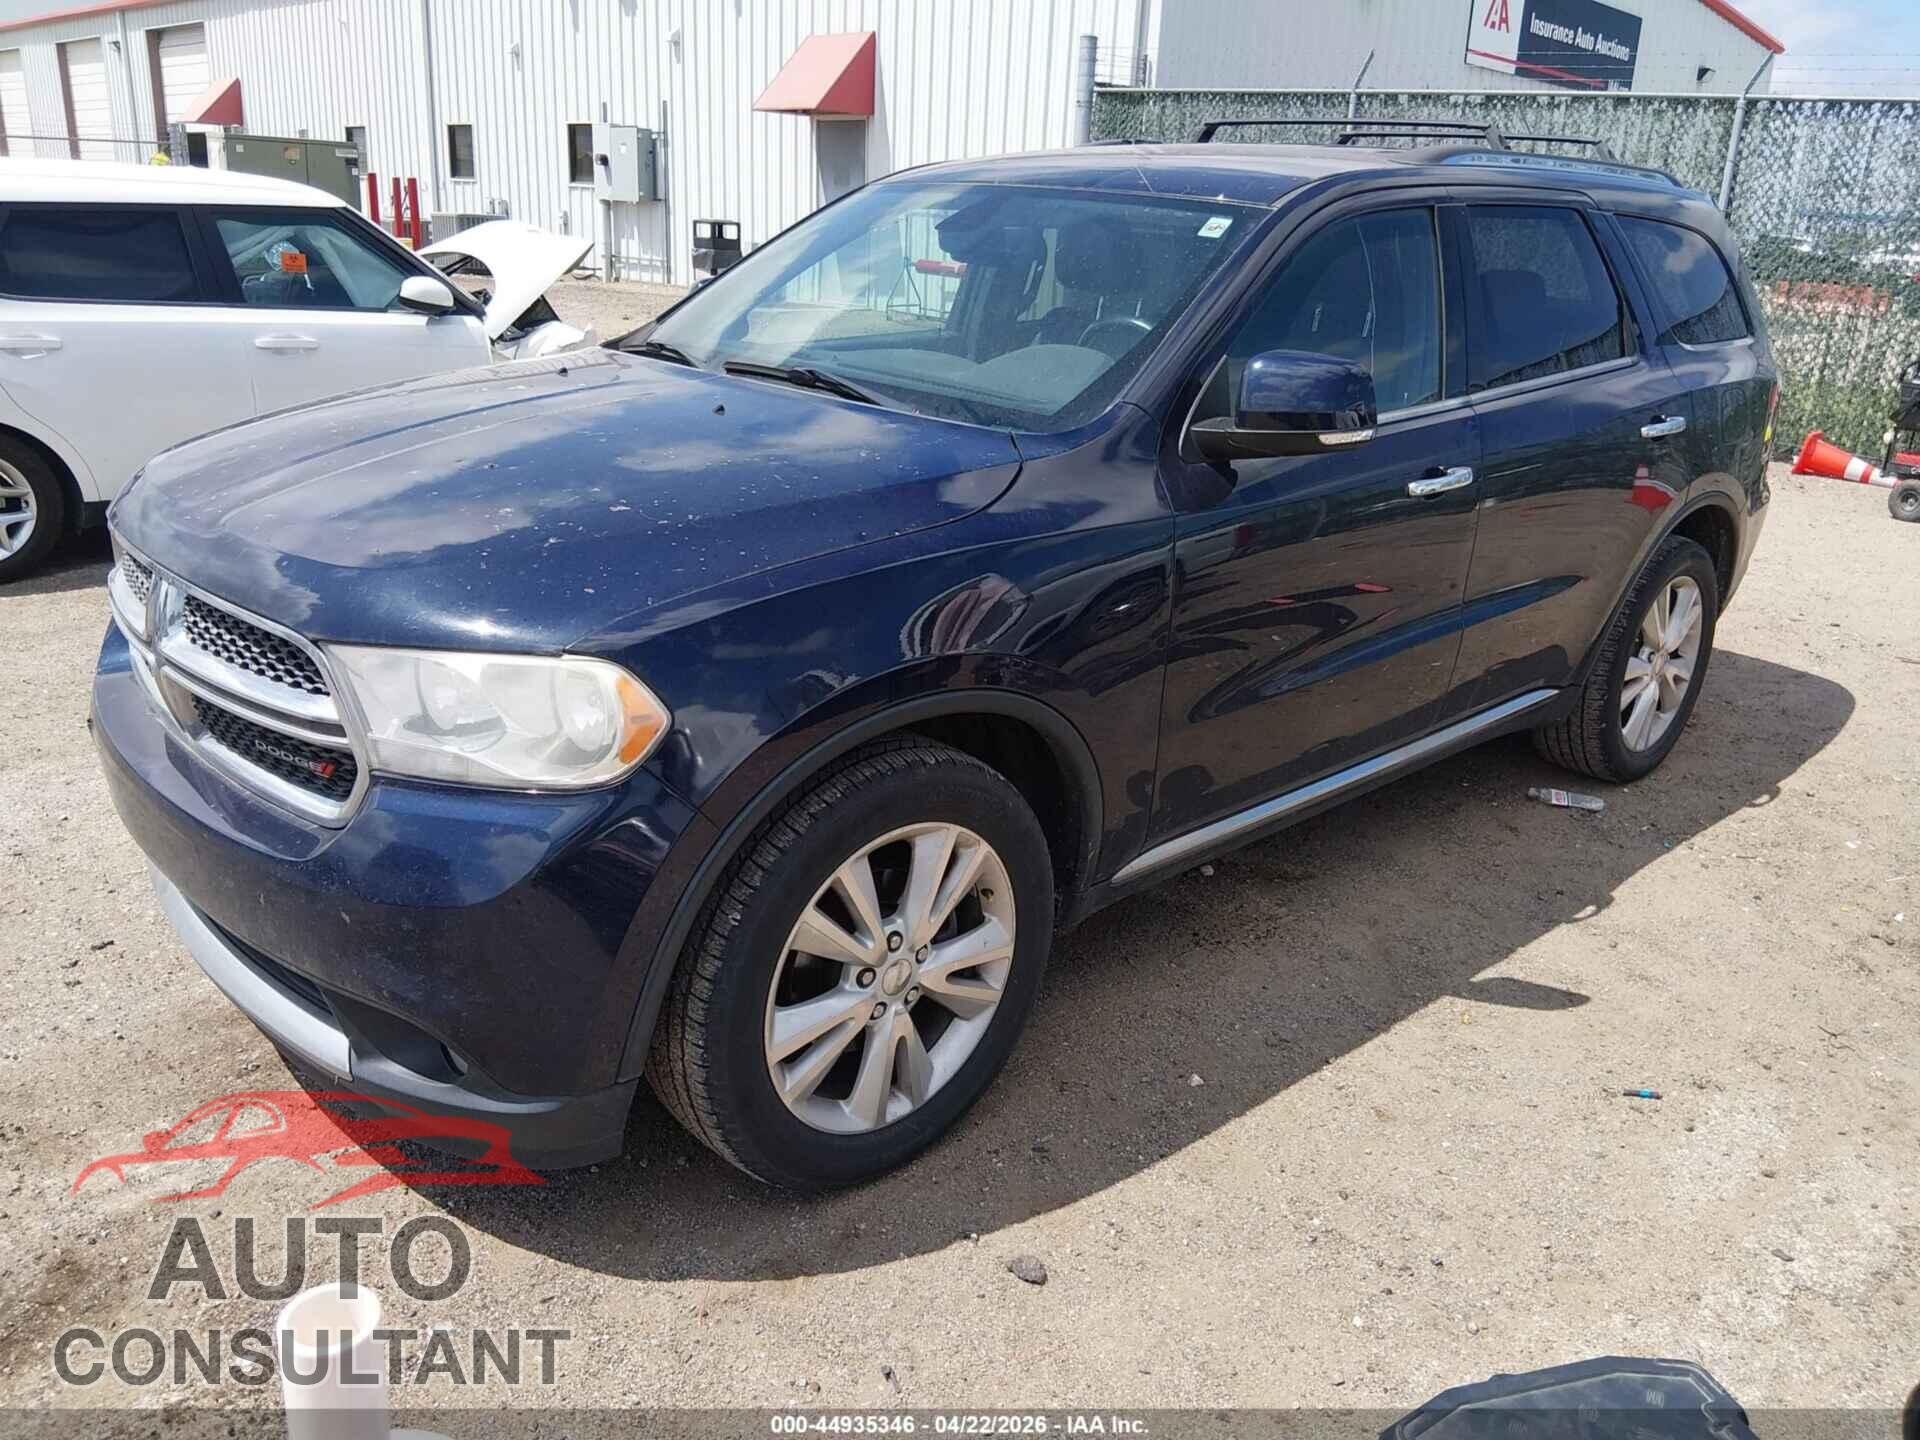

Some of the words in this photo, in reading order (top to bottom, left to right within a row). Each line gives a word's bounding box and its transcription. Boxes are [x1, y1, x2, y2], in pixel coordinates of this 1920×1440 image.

[1530, 12, 1574, 44] Insurance
[1574, 26, 1595, 51] Auto
[1594, 33, 1630, 61] Auctions
[255, 740, 326, 777] DODGE
